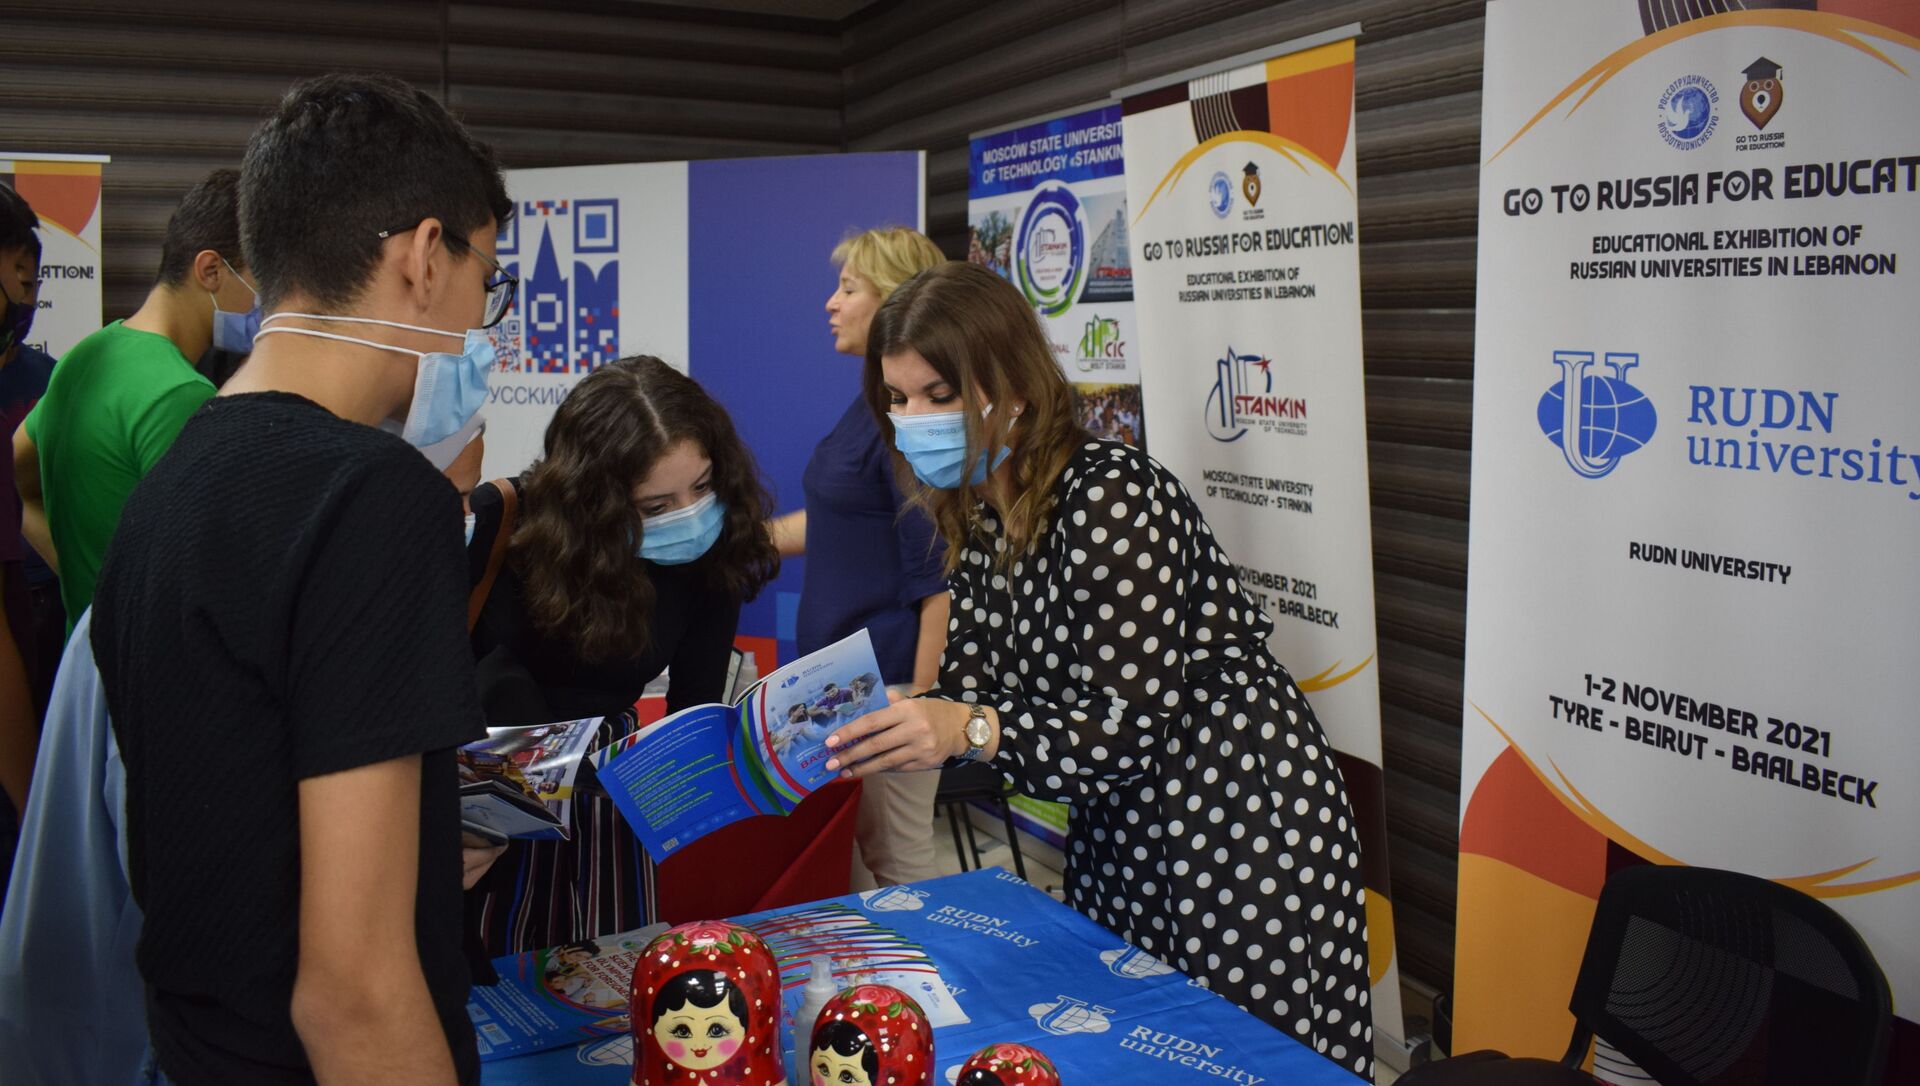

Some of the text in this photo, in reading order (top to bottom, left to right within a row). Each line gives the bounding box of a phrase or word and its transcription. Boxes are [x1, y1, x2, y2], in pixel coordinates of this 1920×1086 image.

[983, 142, 1029, 165] MOSCOW
[1030, 135, 1062, 155] STATE
[1736, 136, 1747, 144] GO
[1760, 132, 1785, 141] RUSSIA
[983, 169, 996, 185] OF
[999, 154, 1068, 181] TECHNOLOGY
[1503, 187, 1543, 216] GO
[1551, 183, 1591, 213] TO
[1597, 173, 1698, 210] RUSSIA
[1706, 168, 1774, 204] FOR
[1143, 221, 1354, 261] GO TO RUSSIA FOR EDUCATION!
[1592, 224, 1863, 254] EDUCATIONAL EXHIBITION OF
[38, 265, 94, 280] ATION!
[1187, 267, 1300, 287] EDUCATIONAL EXHIBITION OF
[1570, 253, 1897, 280] RUSSIAN UNIVERSITIES IN LEBANON
[1179, 284, 1316, 303] RUSSIAN UNIVERSITIES IN LEBANON
[1234, 395, 1307, 419] STANKIN
[1687, 385, 1839, 434] RUDN
[1203, 470, 1314, 497] MOSCOW STATE UNIVERSITY
[1206, 486, 1217, 497] OF
[1219, 487, 1269, 507] TECHNOLOGY
[1277, 497, 1313, 514] STANKIN
[1629, 541, 1792, 585] RUDN UNIVERSITY
[1291, 578, 1317, 600] 2021
[1279, 598, 1339, 629] BAALBECK
[1584, 673, 1831, 758] 1-2 NOVEMBER 2021
[1549, 694, 1604, 733] TYRE
[1625, 715, 1708, 761] BEIRUT
[1732, 745, 1879, 809] BAALBECK
[926, 912, 1040, 948] university
[935, 904, 1012, 928] RUDN
[1127, 1024, 1223, 1058] RUDN
[1119, 1037, 1265, 1086] university
